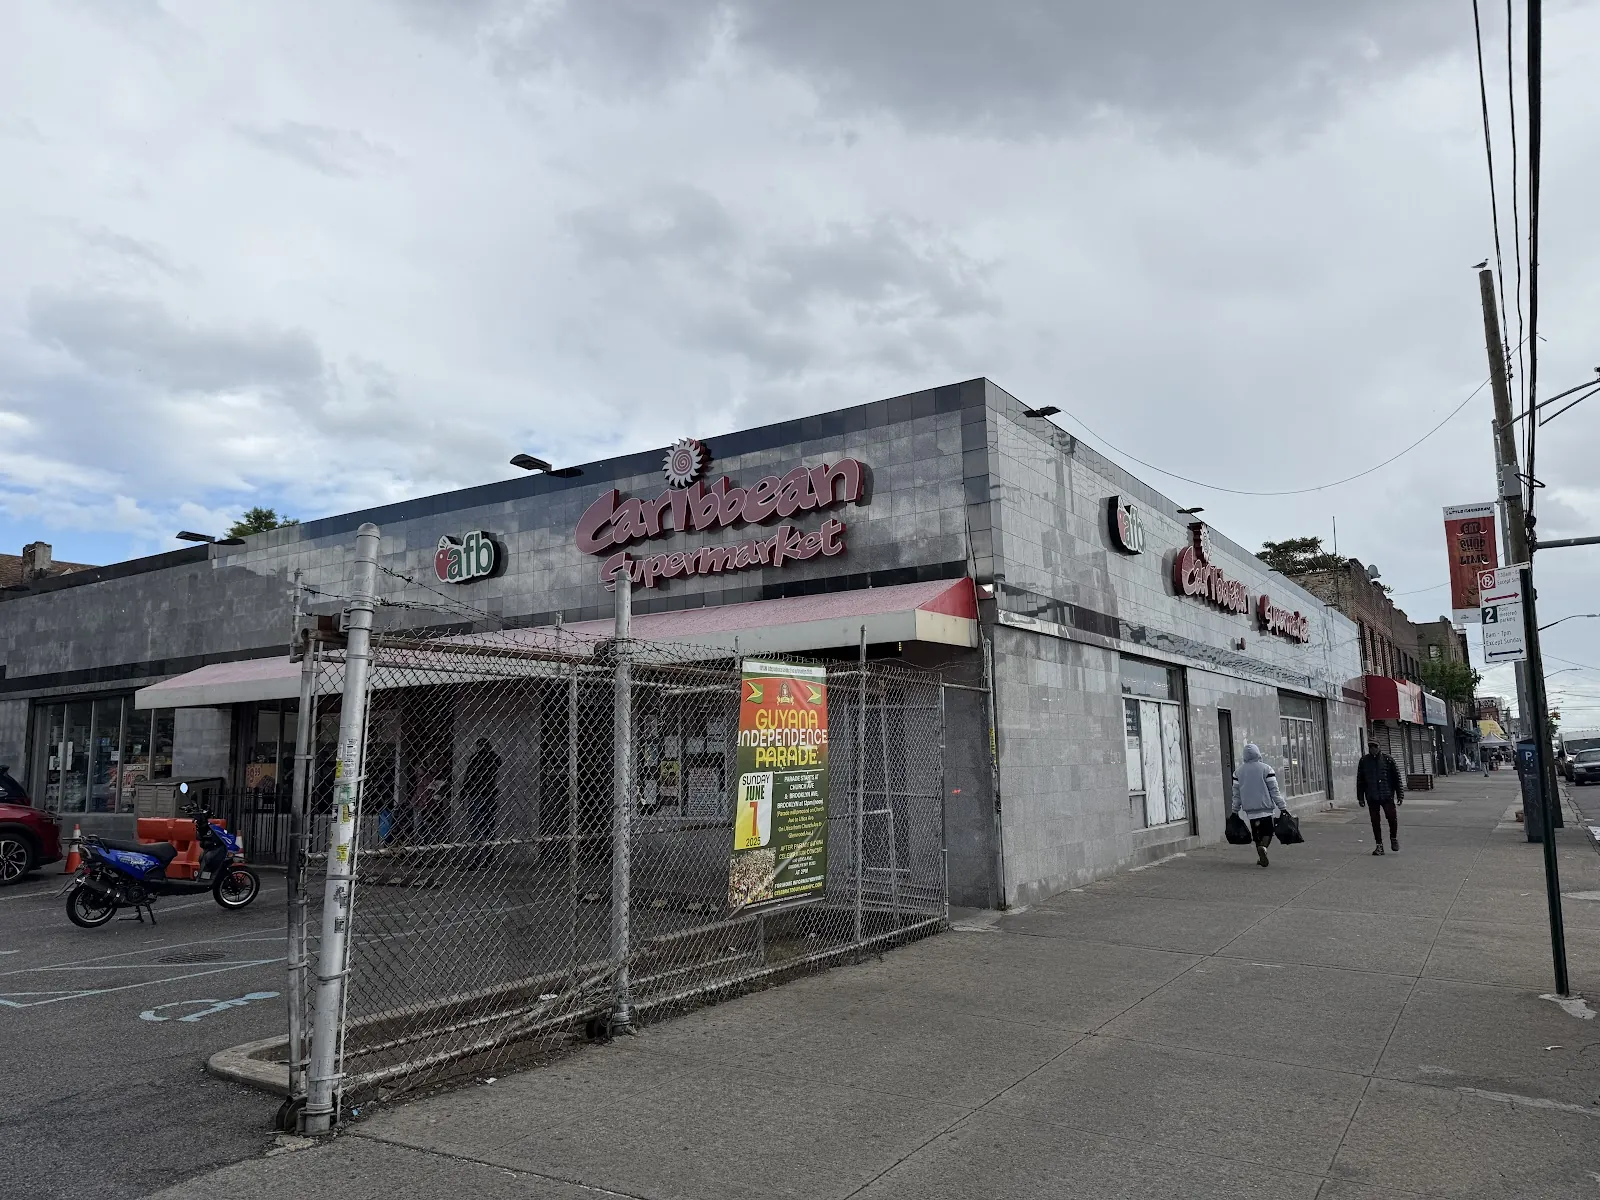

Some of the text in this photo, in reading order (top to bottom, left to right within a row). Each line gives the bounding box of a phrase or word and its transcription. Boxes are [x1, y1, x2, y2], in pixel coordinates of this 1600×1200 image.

[574, 457, 864, 556] Caribbean
[1460, 538, 1485, 552] SHOP
[447, 531, 493, 581] afb
[600, 518, 846, 592] Supermarket
[1180, 545, 1251, 615] Caribbean
[1485, 608, 1495, 623] 2
[1503, 637, 1522, 645] Sunday
[755, 708, 818, 730] GUYANA
[737, 728, 828, 747] INDEPENDENCE
[742, 774, 771, 786] SUNDAY
[746, 785, 765, 801] JUNE
[789, 791, 811, 799] BROOKLYN
[776, 801, 798, 809] BROOKLYN
[750, 801, 759, 837] 1
[746, 837, 761, 848] 2025
